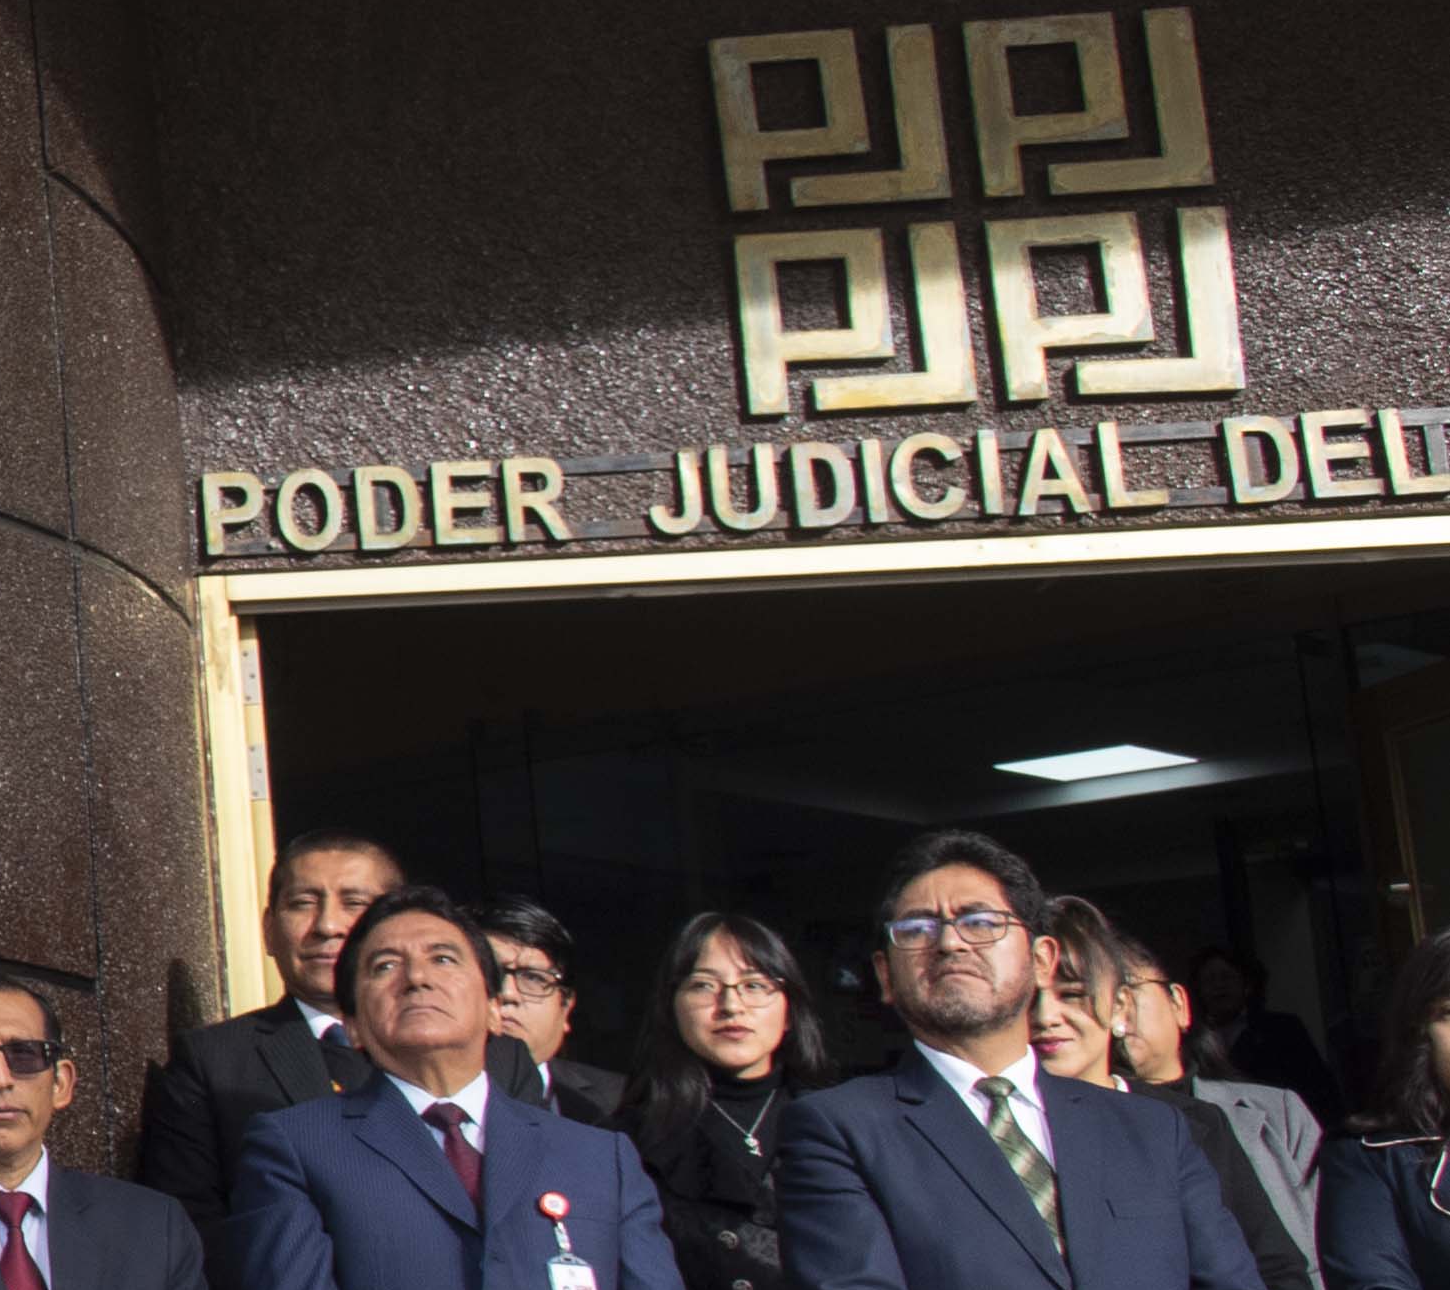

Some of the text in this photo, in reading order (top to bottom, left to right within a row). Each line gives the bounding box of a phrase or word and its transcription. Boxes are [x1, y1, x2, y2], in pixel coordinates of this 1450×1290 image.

[201, 408, 1450, 556] PODER JUDICIAL DEL
